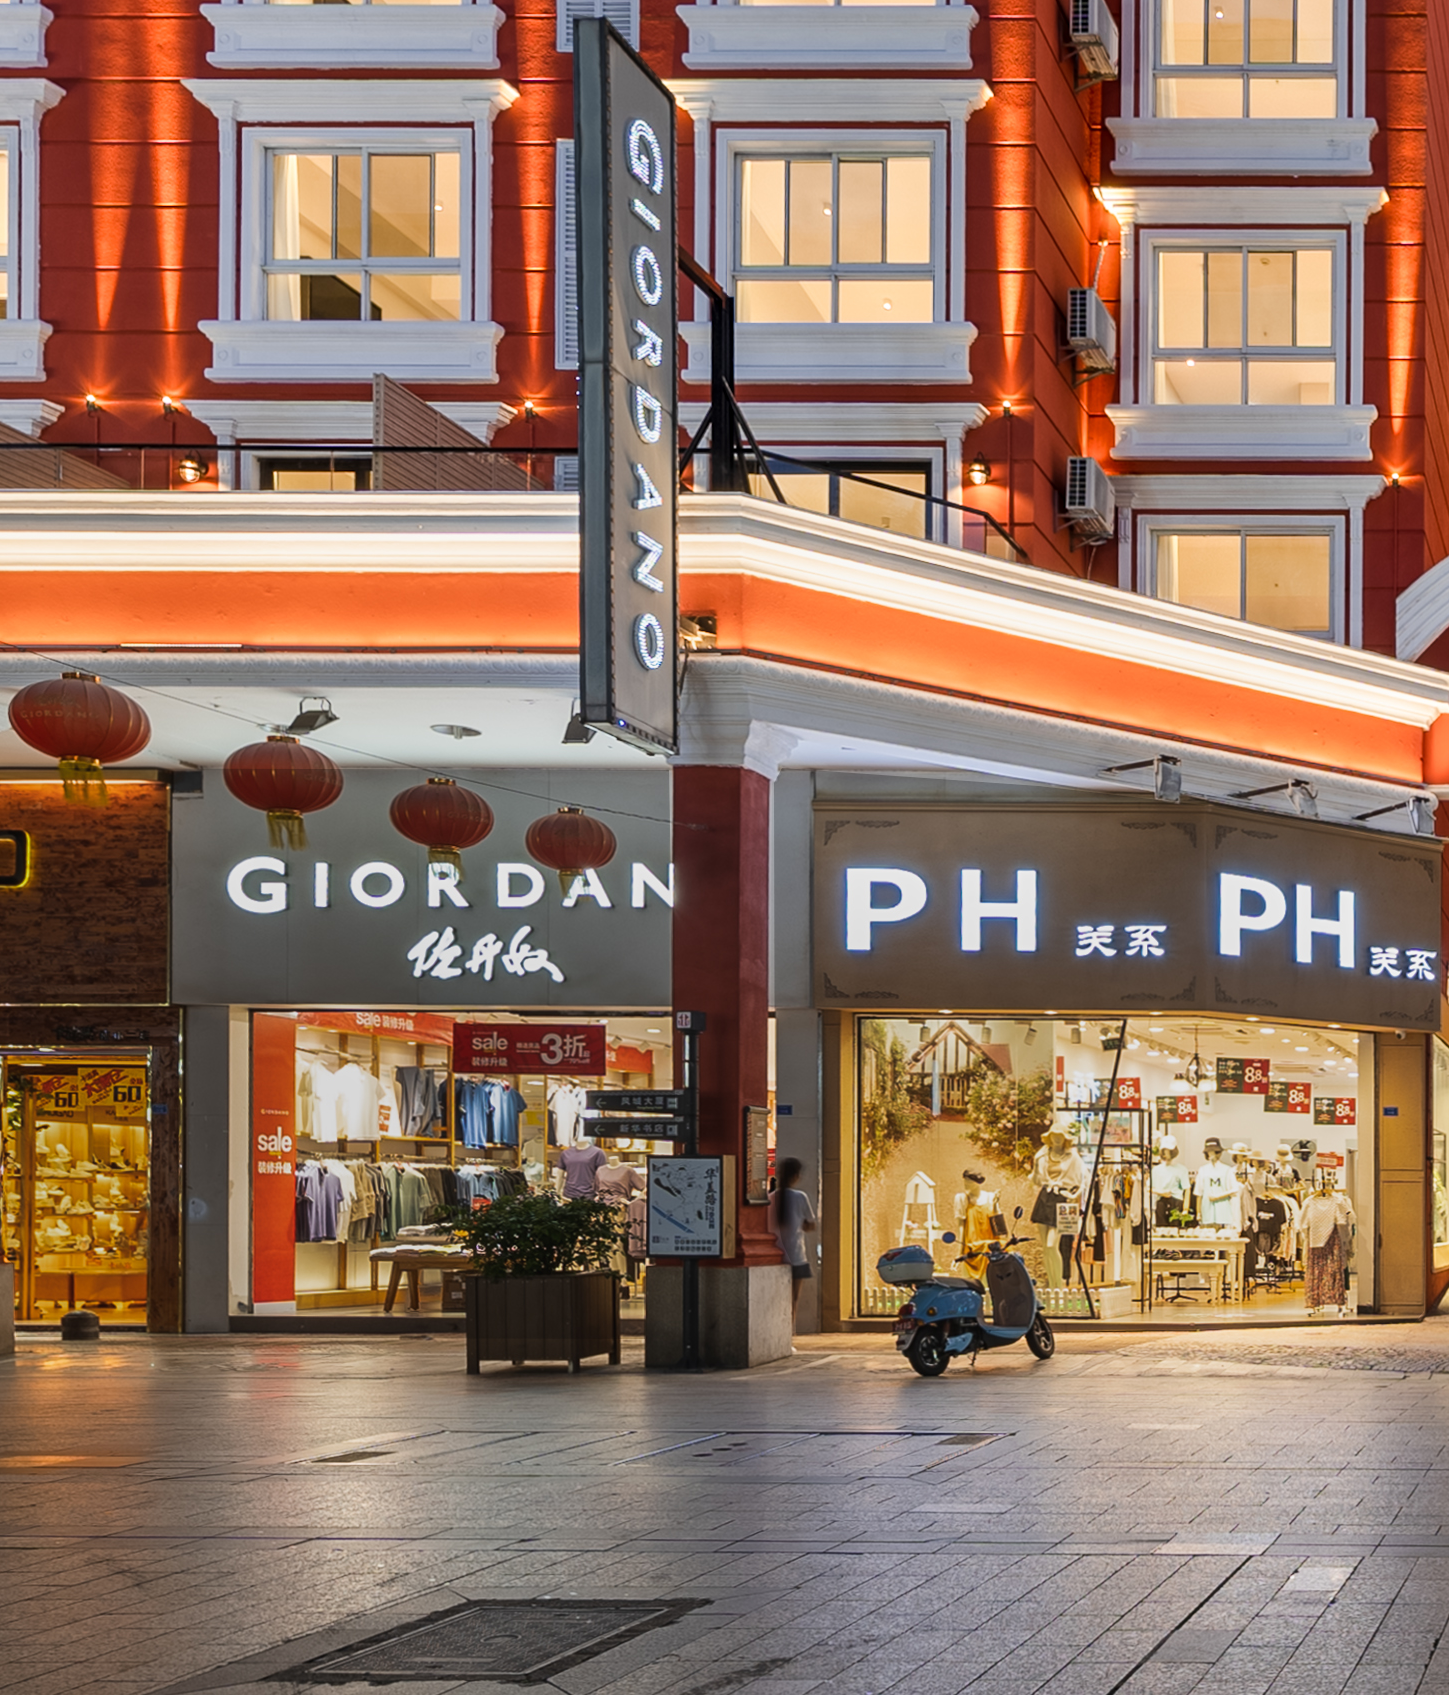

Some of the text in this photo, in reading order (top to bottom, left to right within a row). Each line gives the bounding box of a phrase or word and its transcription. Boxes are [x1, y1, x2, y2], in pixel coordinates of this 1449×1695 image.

[624, 117, 665, 672] GIORDANO
[226, 855, 674, 914] GIORDAN
[1219, 871, 1355, 970] PH
[472, 1031, 508, 1050] sale
[257, 1126, 293, 1153] sale
